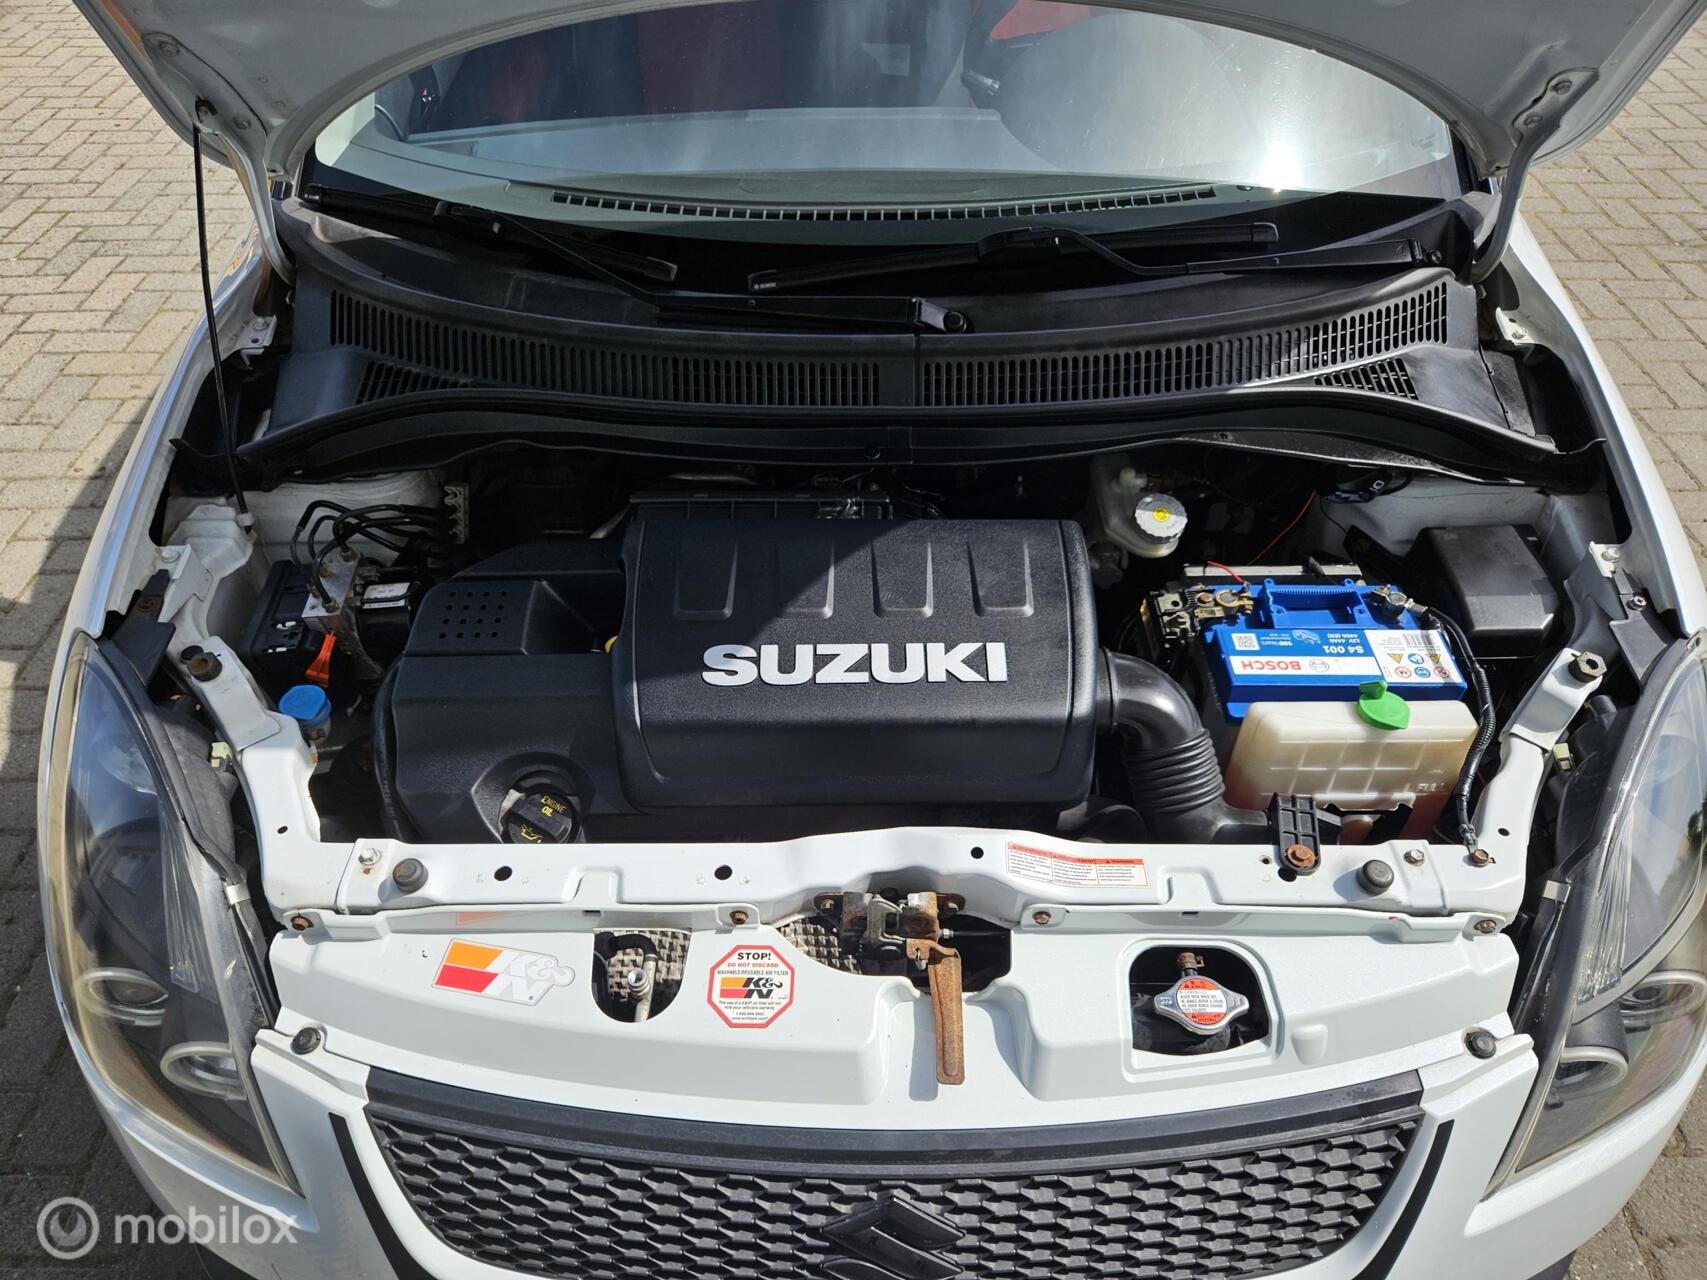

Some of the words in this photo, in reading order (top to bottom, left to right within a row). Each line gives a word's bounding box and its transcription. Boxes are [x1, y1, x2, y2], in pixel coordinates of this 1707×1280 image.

[1322, 645, 1346, 654] 001
[1348, 645, 1365, 654] S4
[701, 642, 1007, 687] SUZUKI
[1240, 660, 1302, 671] BOSCH
[541, 795, 567, 813] ENGINE
[542, 806, 553, 816] OIL
[737, 952, 771, 960] STOP!
